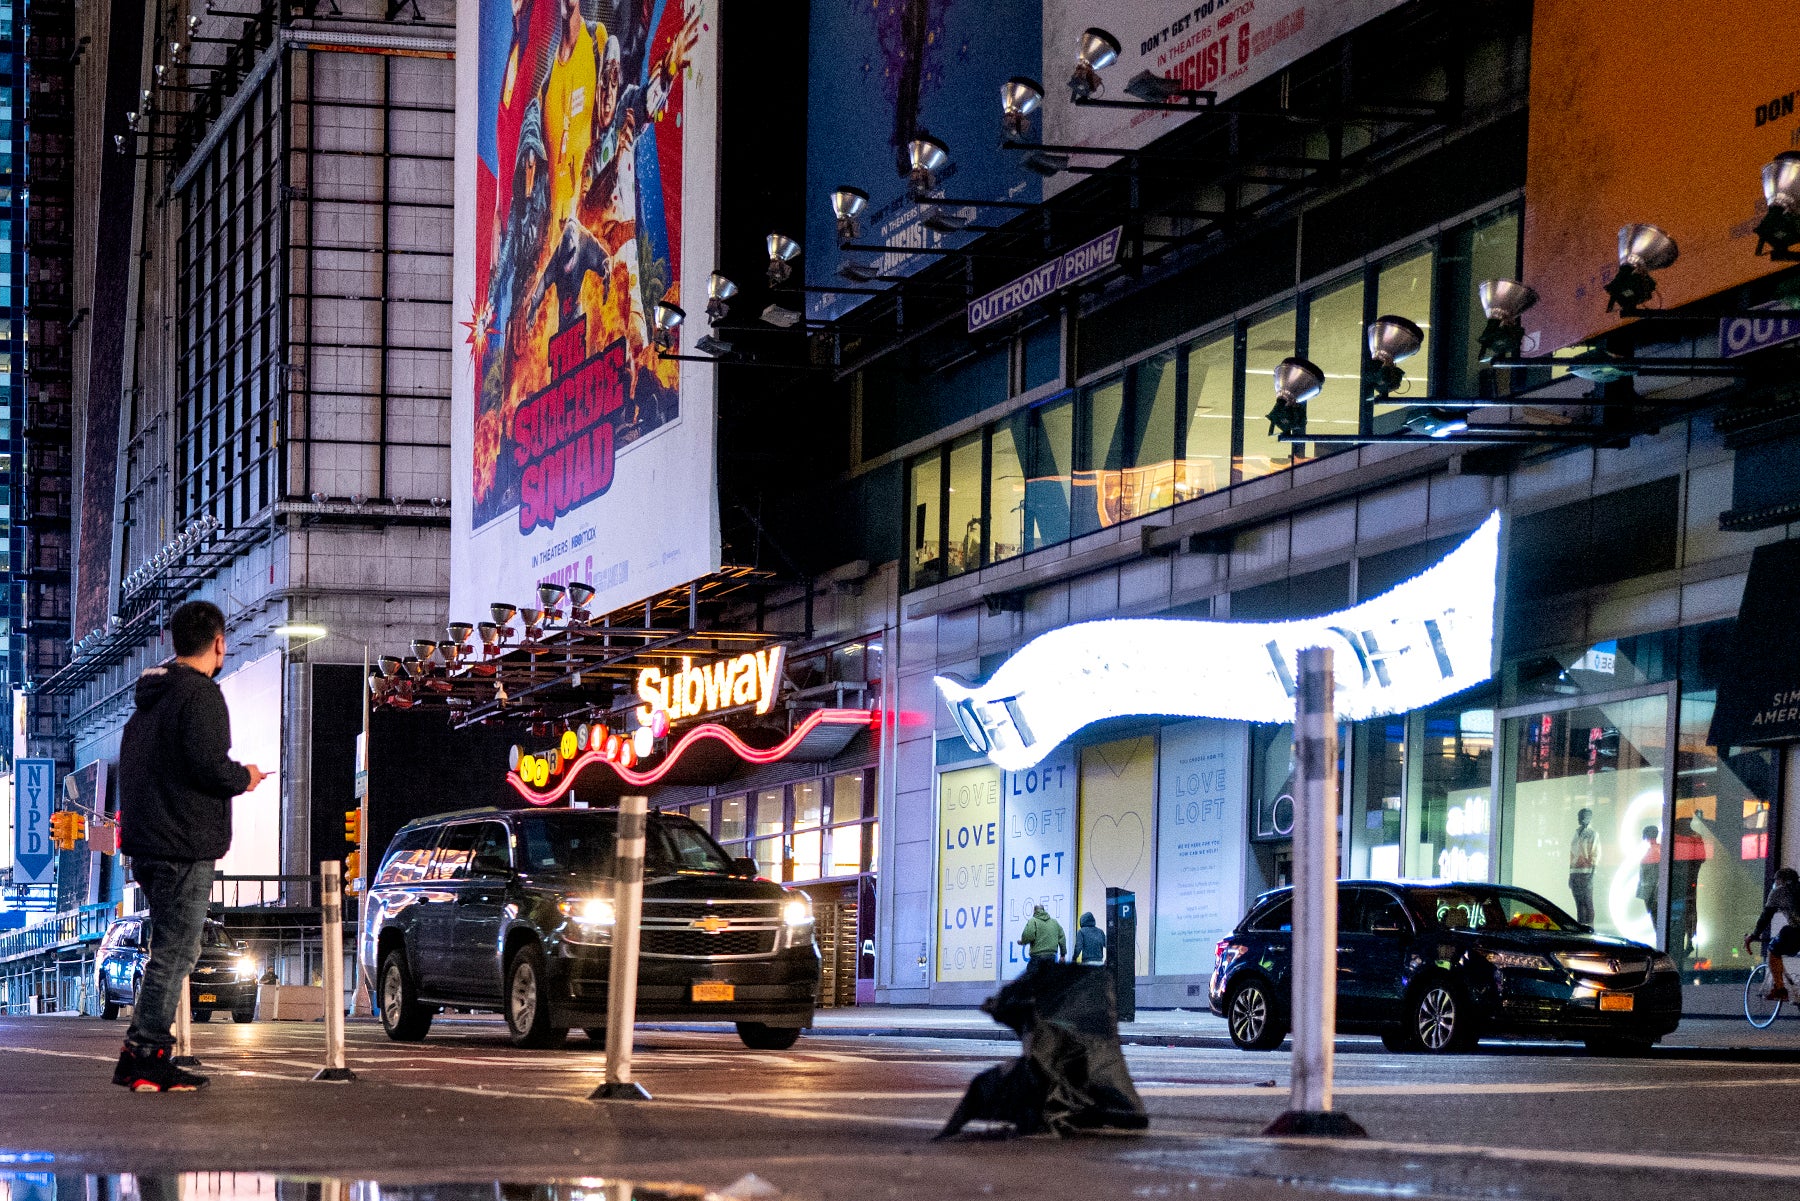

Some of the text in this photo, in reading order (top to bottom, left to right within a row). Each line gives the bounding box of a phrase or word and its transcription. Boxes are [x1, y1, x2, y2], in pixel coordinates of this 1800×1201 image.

[1141, 28, 1169, 56] DON'T
[1171, 14, 1191, 37] GET
[971, 237, 1114, 326] OUTFRONT PRIME
[550, 326, 586, 379] THE
[514, 345, 624, 467] SUICIDE
[521, 422, 614, 530] SQUAD
[636, 646, 783, 727] Subway
[1752, 708, 1800, 727] AMER
[1013, 765, 1066, 796] LOFT
[1175, 769, 1226, 798] LOVE
[947, 781, 998, 811] LOVE
[26, 768, 42, 855] NYPD
[1012, 807, 1065, 839] LOFT
[1175, 798, 1226, 826] LOFT
[1257, 794, 1296, 837] LO
[947, 822, 996, 850] LOVE
[945, 863, 996, 891] LOVE
[1012, 852, 1065, 880] LOFT
[945, 905, 994, 930] LOVE
[943, 945, 993, 970] LOVE
[1009, 941, 1031, 963] LO
